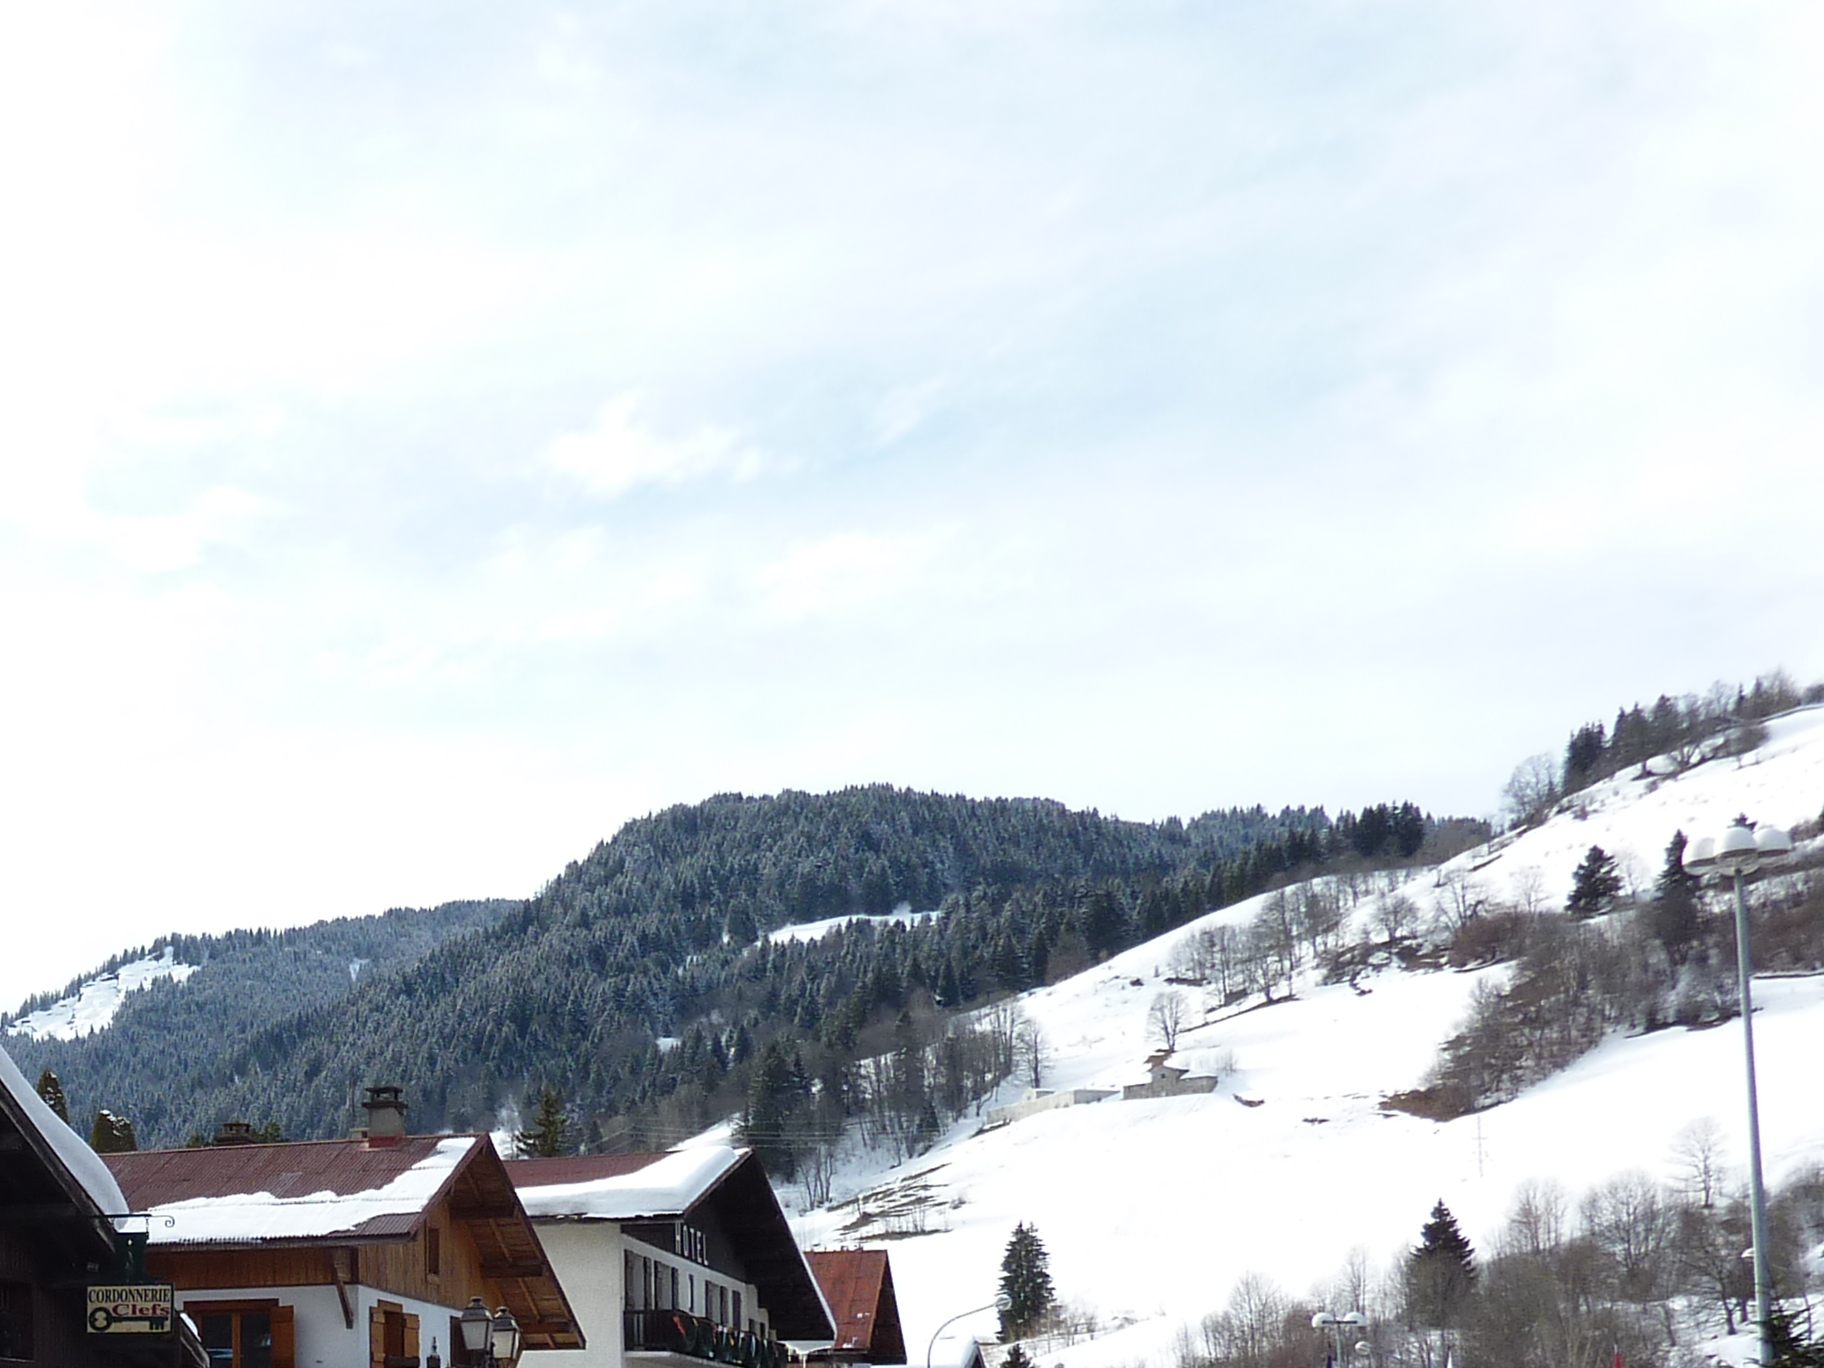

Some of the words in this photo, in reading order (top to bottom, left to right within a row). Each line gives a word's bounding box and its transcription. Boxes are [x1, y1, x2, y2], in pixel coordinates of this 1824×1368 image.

[675, 1221, 709, 1266] HOTEL
[88, 1288, 171, 1304] CORDONNERIE
[112, 1303, 170, 1316] Clefs
